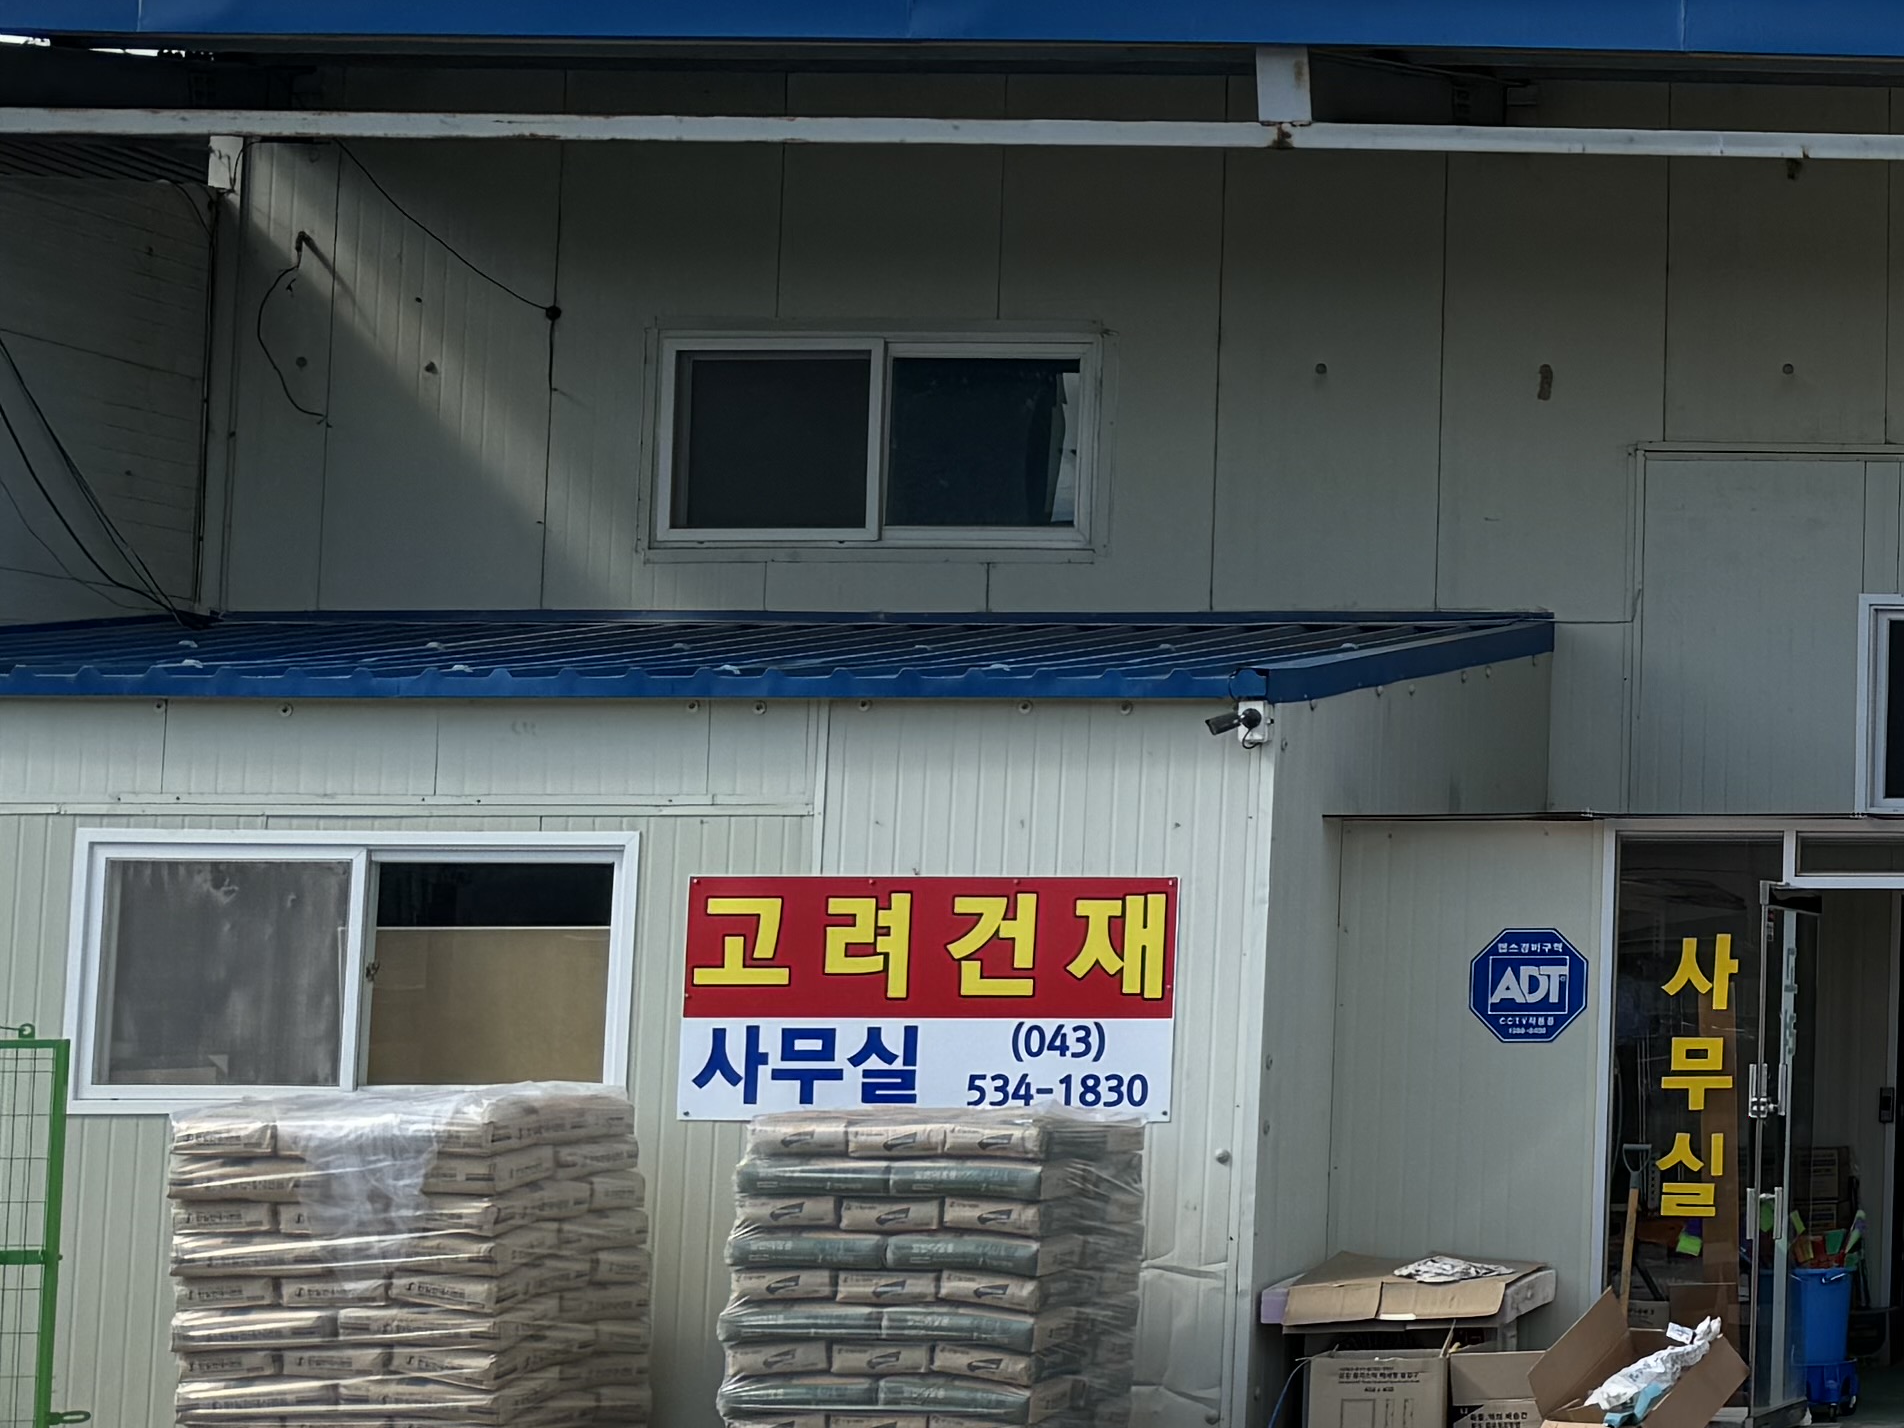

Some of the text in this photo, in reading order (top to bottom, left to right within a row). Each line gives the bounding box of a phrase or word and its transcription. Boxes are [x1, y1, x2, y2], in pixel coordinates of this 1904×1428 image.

[691, 891, 1168, 1000] 고려건재
[1491, 965, 1568, 1004] ADT
[692, 1024, 919, 1105] 사무실
[1010, 1021, 1106, 1063] (043)
[966, 1072, 1149, 1108] 534-1830
[1655, 933, 1739, 1217] 사무실
